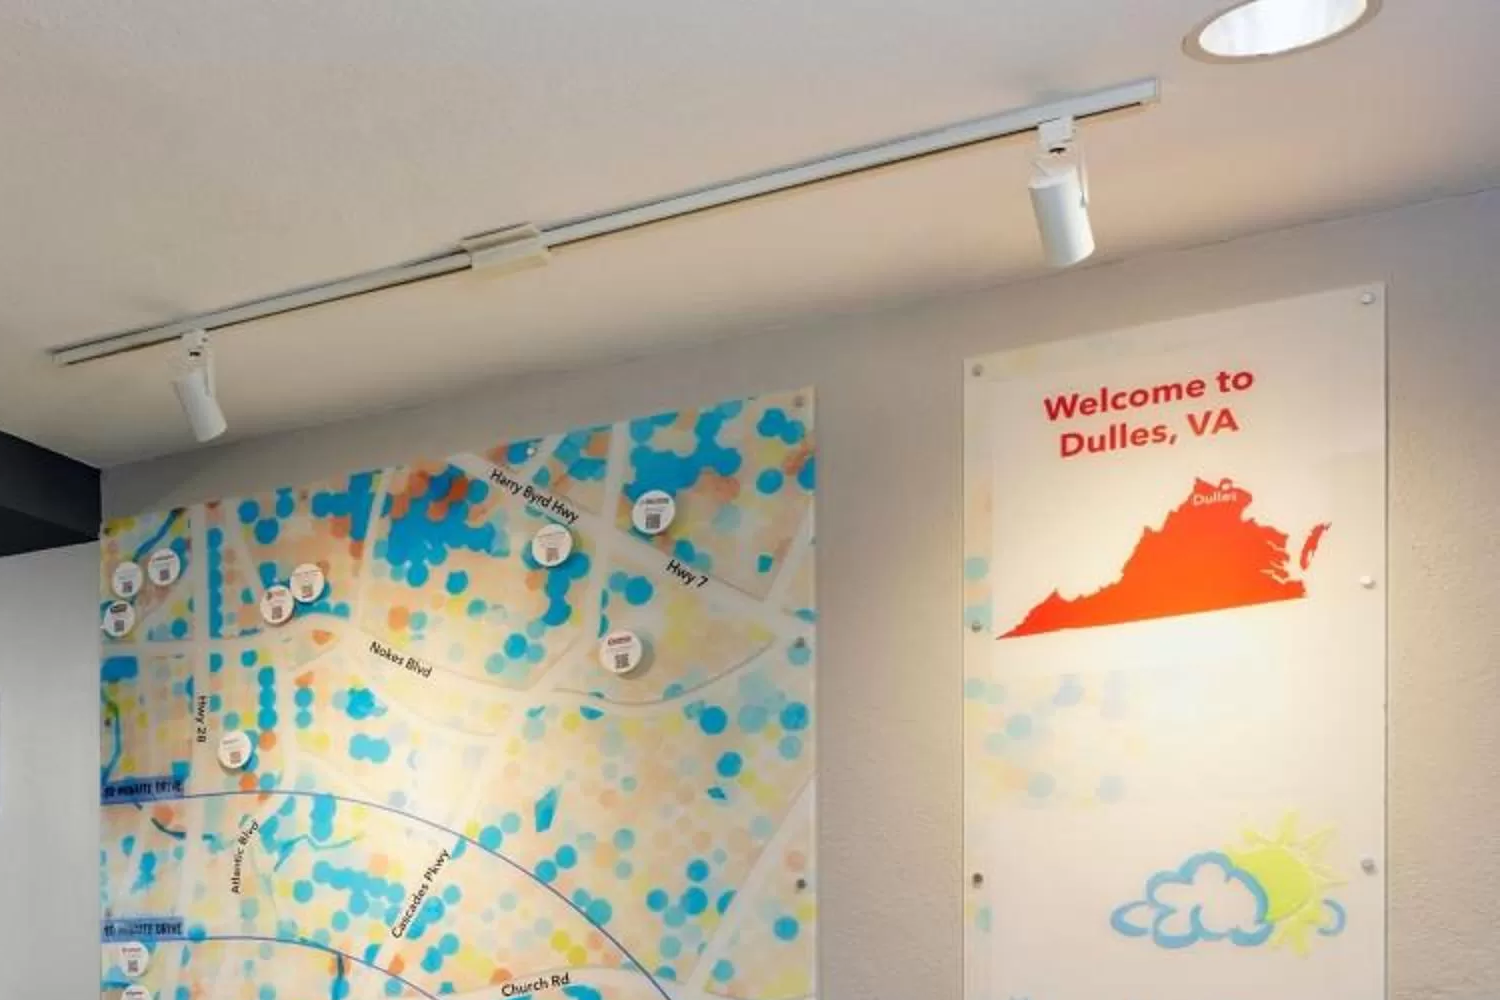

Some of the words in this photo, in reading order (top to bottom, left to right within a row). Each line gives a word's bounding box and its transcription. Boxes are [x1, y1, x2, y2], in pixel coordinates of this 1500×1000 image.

[1043, 379, 1206, 421] Welcome
[1216, 369, 1254, 394] to
[1060, 423, 1178, 458] Dulles,
[1187, 408, 1239, 437] VA
[490, 468, 523, 497] Harry
[523, 485, 552, 510] Byrd
[552, 499, 579, 524] Hwy
[666, 559, 696, 586] Hwy
[696, 574, 708, 588] 7
[369, 641, 403, 666] Nokes
[405, 656, 432, 678] Blvd
[197, 695, 207, 724] Hwy
[197, 727, 206, 743] 28
[231, 846, 245, 893] Atlantic
[240, 820, 258, 845] Blvd
[391, 883, 428, 939] Cascades
[424, 849, 451, 882] Pkwy
[501, 977, 548, 998] Church
[551, 973, 570, 986] Rd
